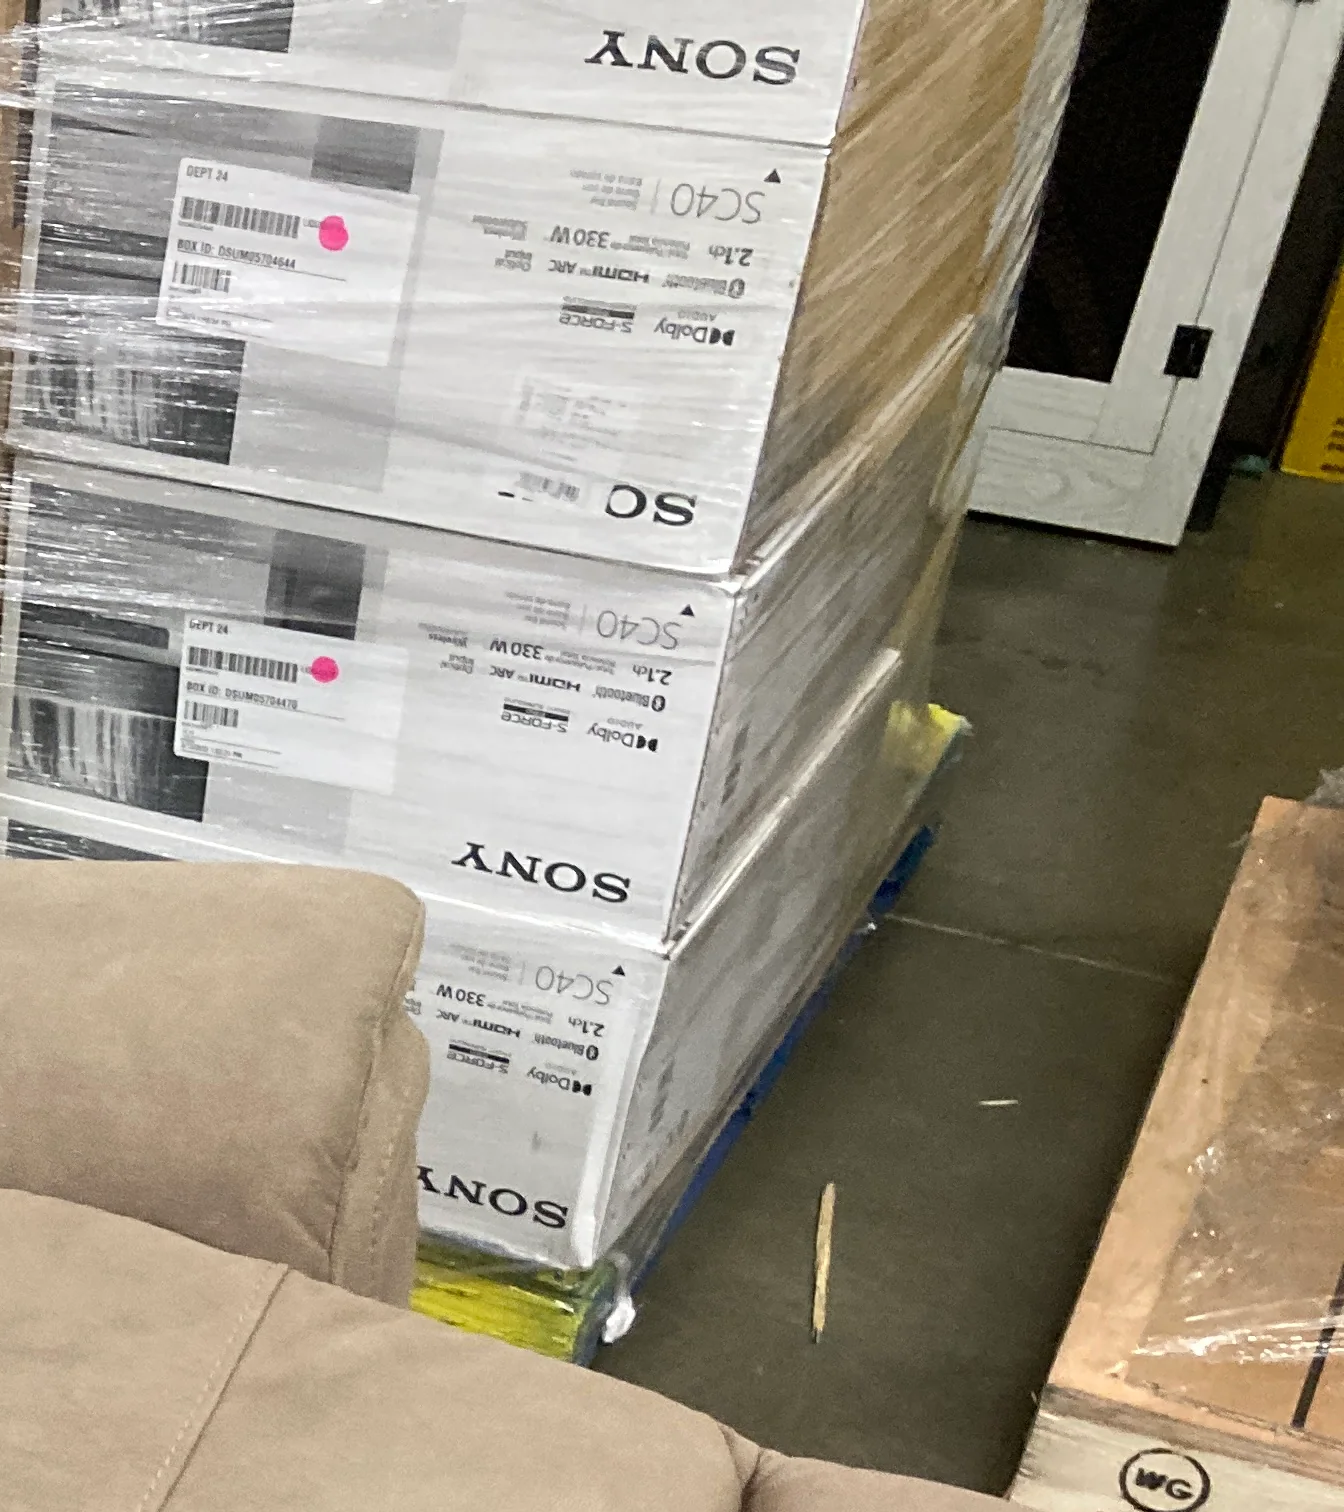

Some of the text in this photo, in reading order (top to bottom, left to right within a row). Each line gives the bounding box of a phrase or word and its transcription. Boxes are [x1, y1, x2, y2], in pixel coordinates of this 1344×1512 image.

[584, 30, 801, 85] SONY
[186, 165, 228, 182] DEPT 24
[670, 182, 765, 224] SC40
[177, 239, 197, 252] BOX
[547, 259, 578, 273] ARC
[654, 318, 707, 345] Dolby
[216, 622, 229, 635] 24
[596, 610, 684, 650] SC40
[489, 665, 516, 679] ARC
[587, 722, 634, 748] Dolby
[451, 841, 631, 903] SONY
[534, 965, 614, 1006] SC40
[527, 1066, 571, 1091] Dolby
